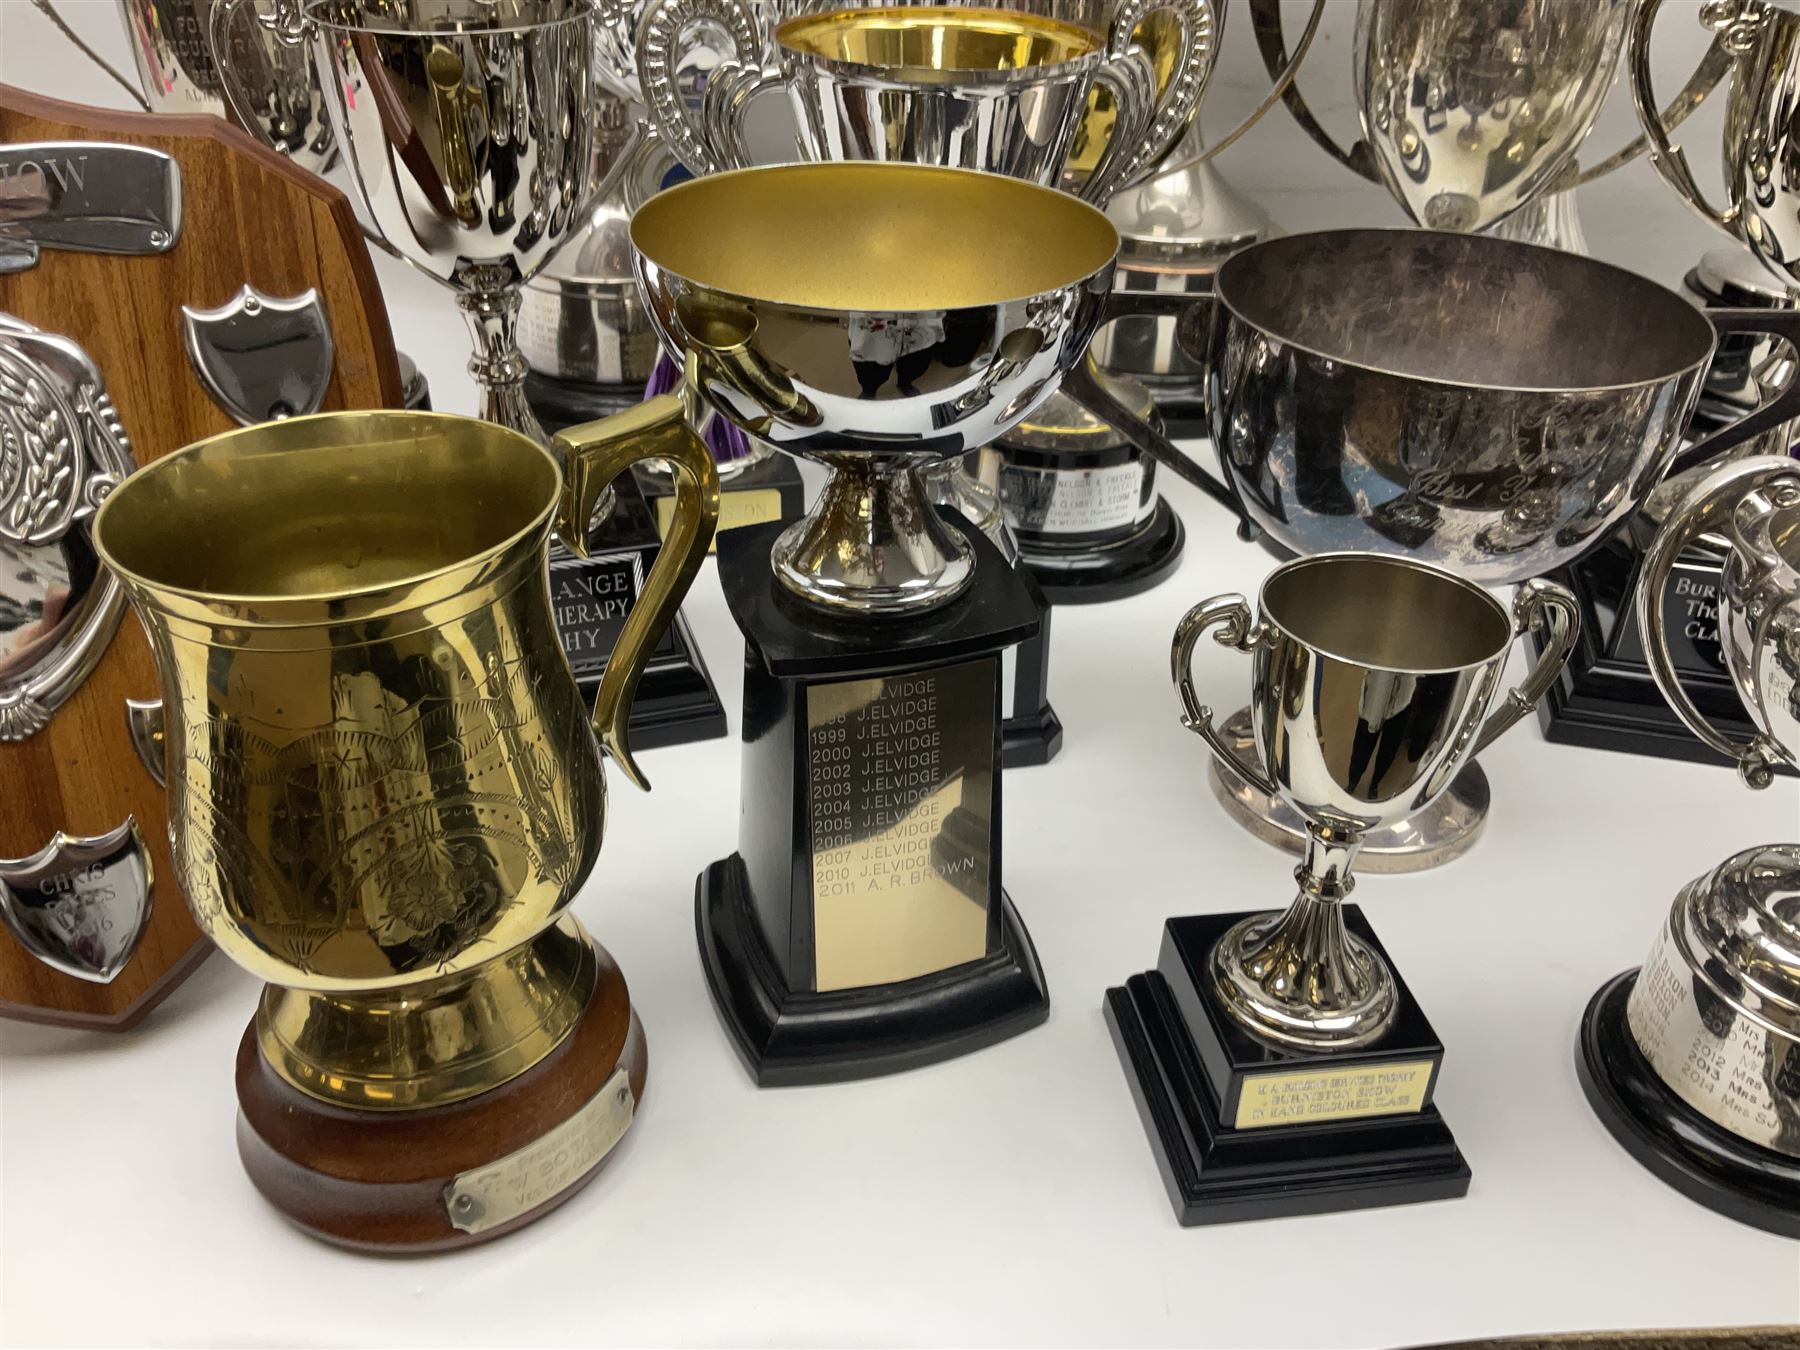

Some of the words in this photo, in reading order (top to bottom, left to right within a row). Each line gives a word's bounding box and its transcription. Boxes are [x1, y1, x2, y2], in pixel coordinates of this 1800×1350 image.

[553, 572, 628, 601] ANGE
[811, 728, 847, 745] 1999
[856, 715, 937, 741] J.ELVIDGE
[812, 746, 852, 764] 2000
[862, 731, 941, 757] J.ELVIDGE
[812, 764, 852, 782] 2002
[861, 750, 941, 776] J.ELVIDGE
[813, 781, 852, 800] 2003
[862, 767, 941, 793] J.ELVIDGE
[814, 800, 852, 817] 2004
[814, 817, 853, 834] 2005
[815, 850, 852, 868] 2007
[861, 836, 932, 862] J.ELVIDG
[816, 867, 850, 884] 2010
[859, 853, 931, 878] J.ELVIDG
[819, 881, 856, 898] 2011
[910, 855, 975, 886] BROWN
